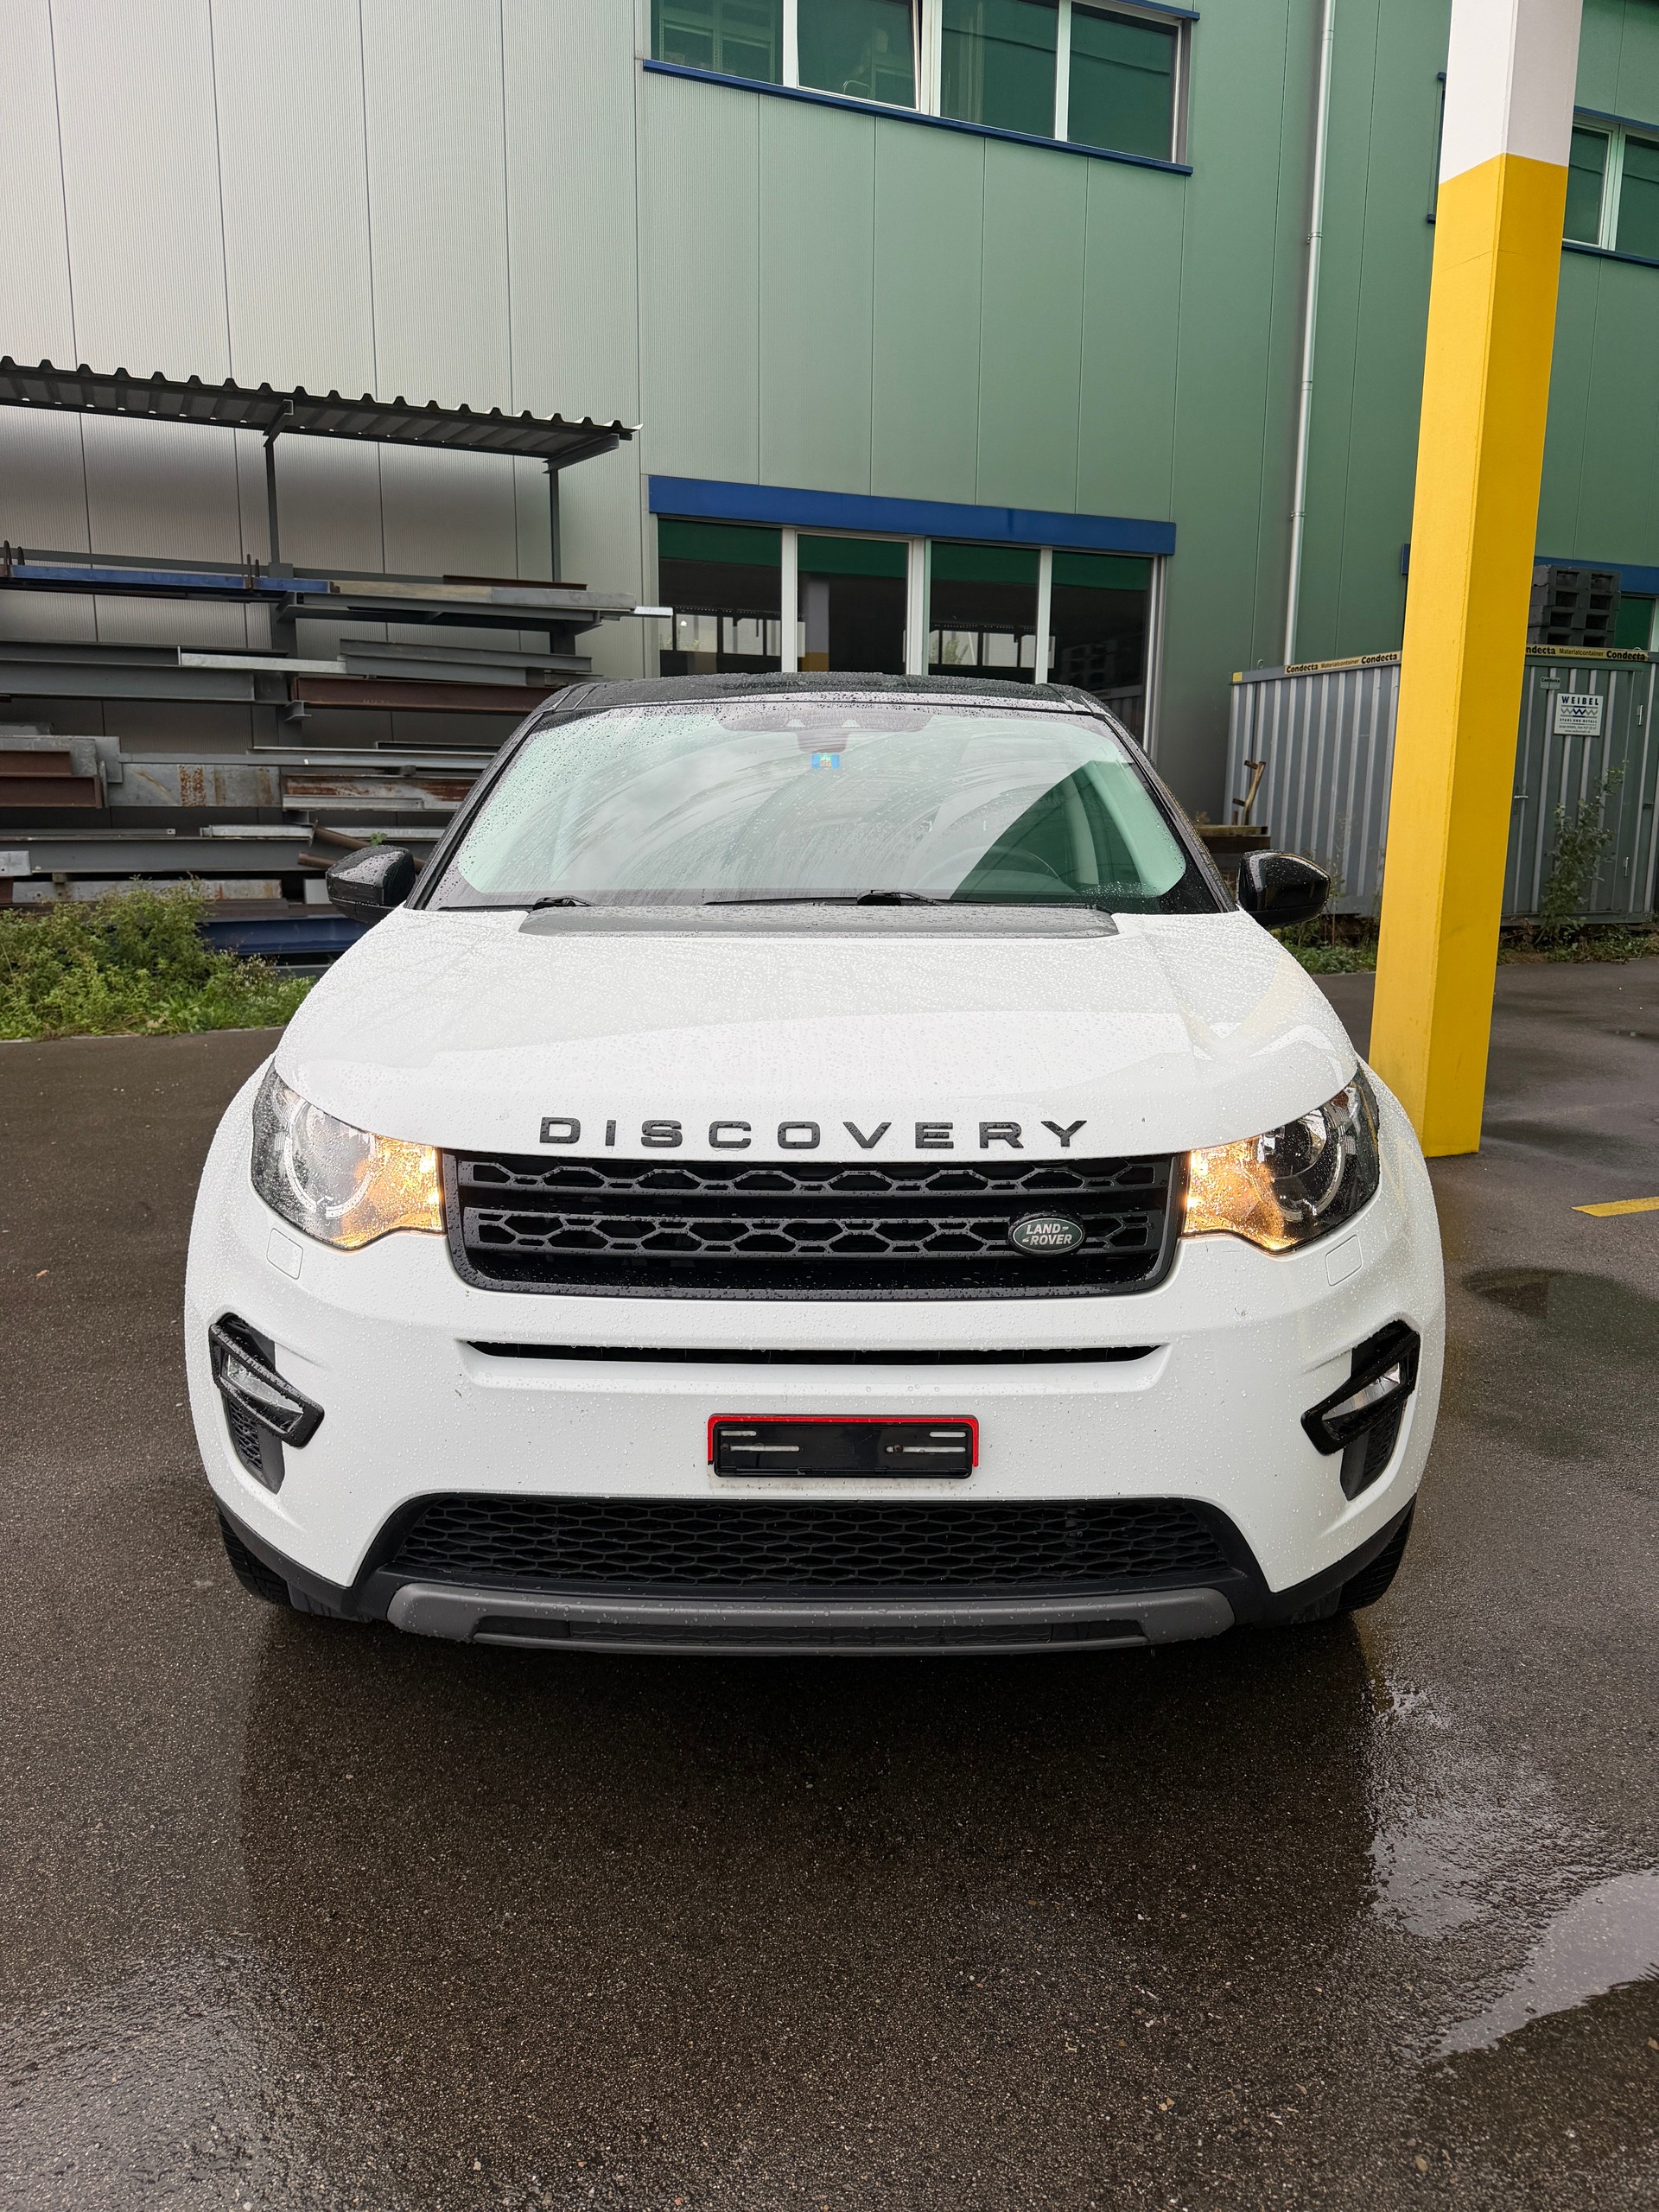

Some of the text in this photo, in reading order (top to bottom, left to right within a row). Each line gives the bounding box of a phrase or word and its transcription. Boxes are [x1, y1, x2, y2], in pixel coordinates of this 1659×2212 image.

[1526, 645, 1646, 660] ndecta Materialcontainer Condecta
[1286, 653, 1397, 673] Condecta Materialcontainer Condecta
[1561, 696, 1599, 706] WEIBEL
[538, 1116, 1087, 1150] DISCOVERY
[1026, 1224, 1061, 1235] LAND
[1030, 1234, 1072, 1245] ROVER
